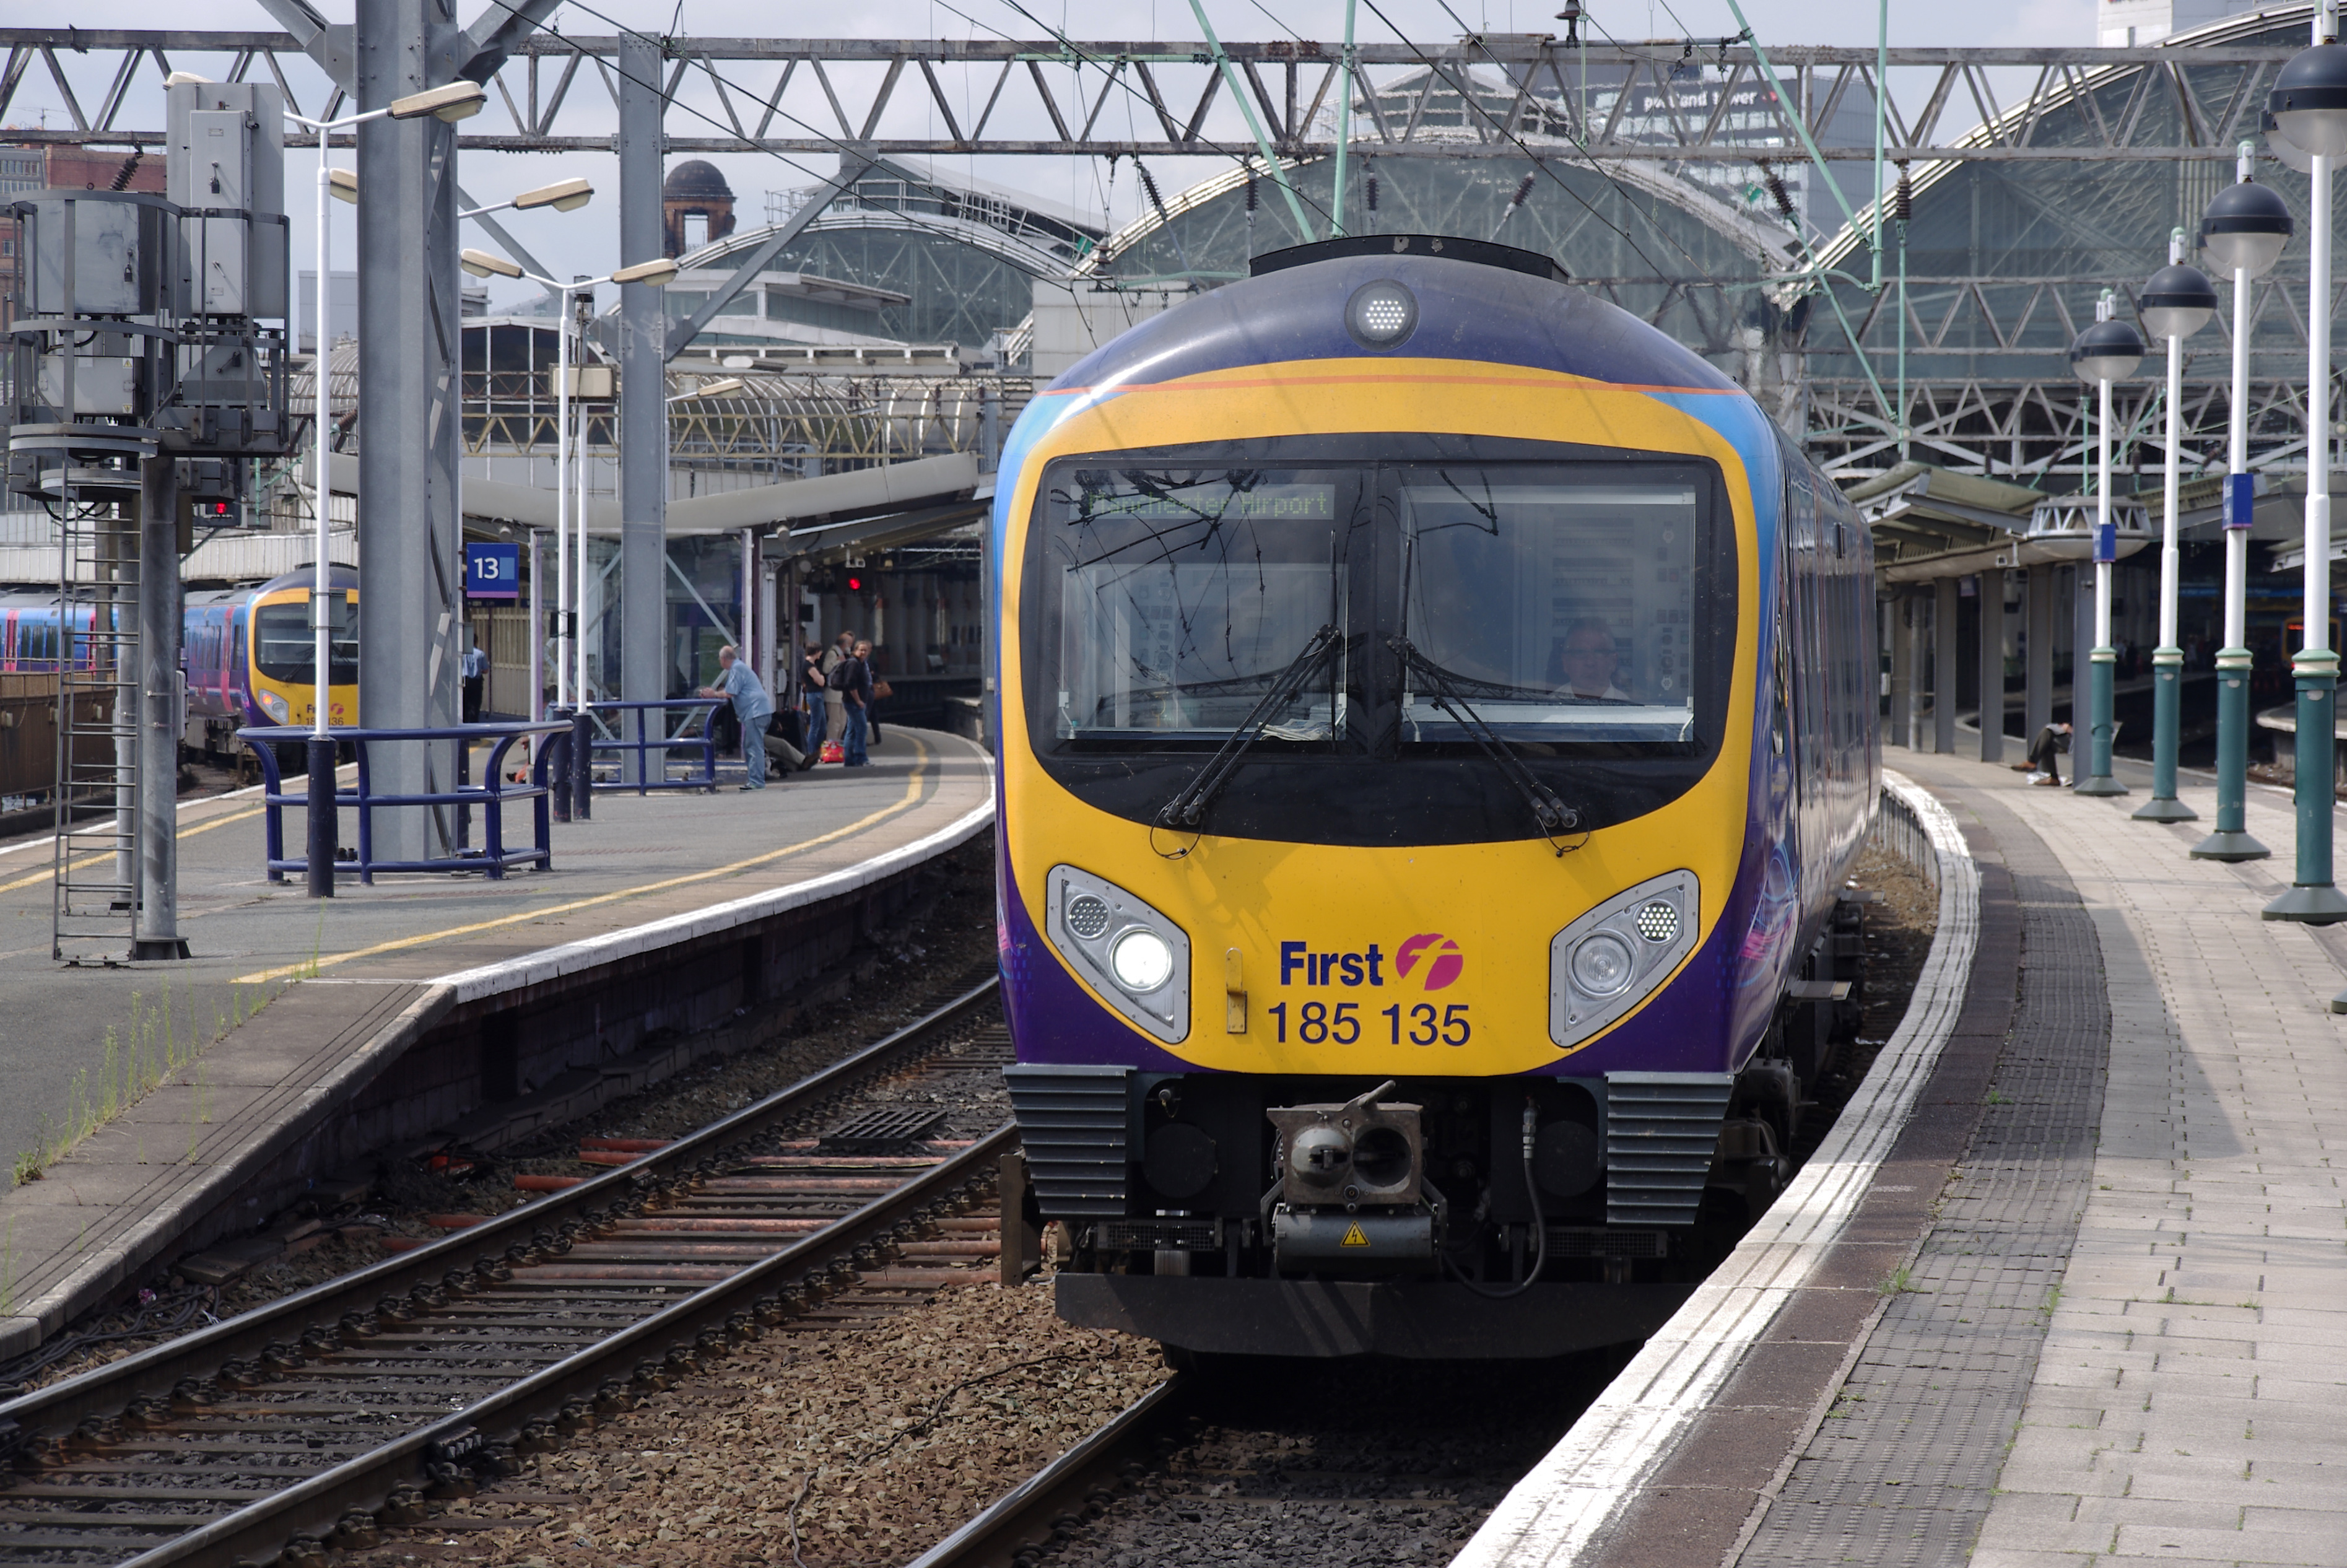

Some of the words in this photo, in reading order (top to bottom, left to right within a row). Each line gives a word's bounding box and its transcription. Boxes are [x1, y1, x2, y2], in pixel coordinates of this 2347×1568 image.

[1644, 90, 1708, 112] potand
[1712, 91, 1757, 106] twer
[1089, 492, 1230, 514] Manchester
[1241, 492, 1327, 517] Airport
[474, 557, 499, 580] 13
[1281, 941, 1383, 986] First
[1268, 1001, 1361, 1045] 185
[1382, 1003, 1471, 1047] 135
